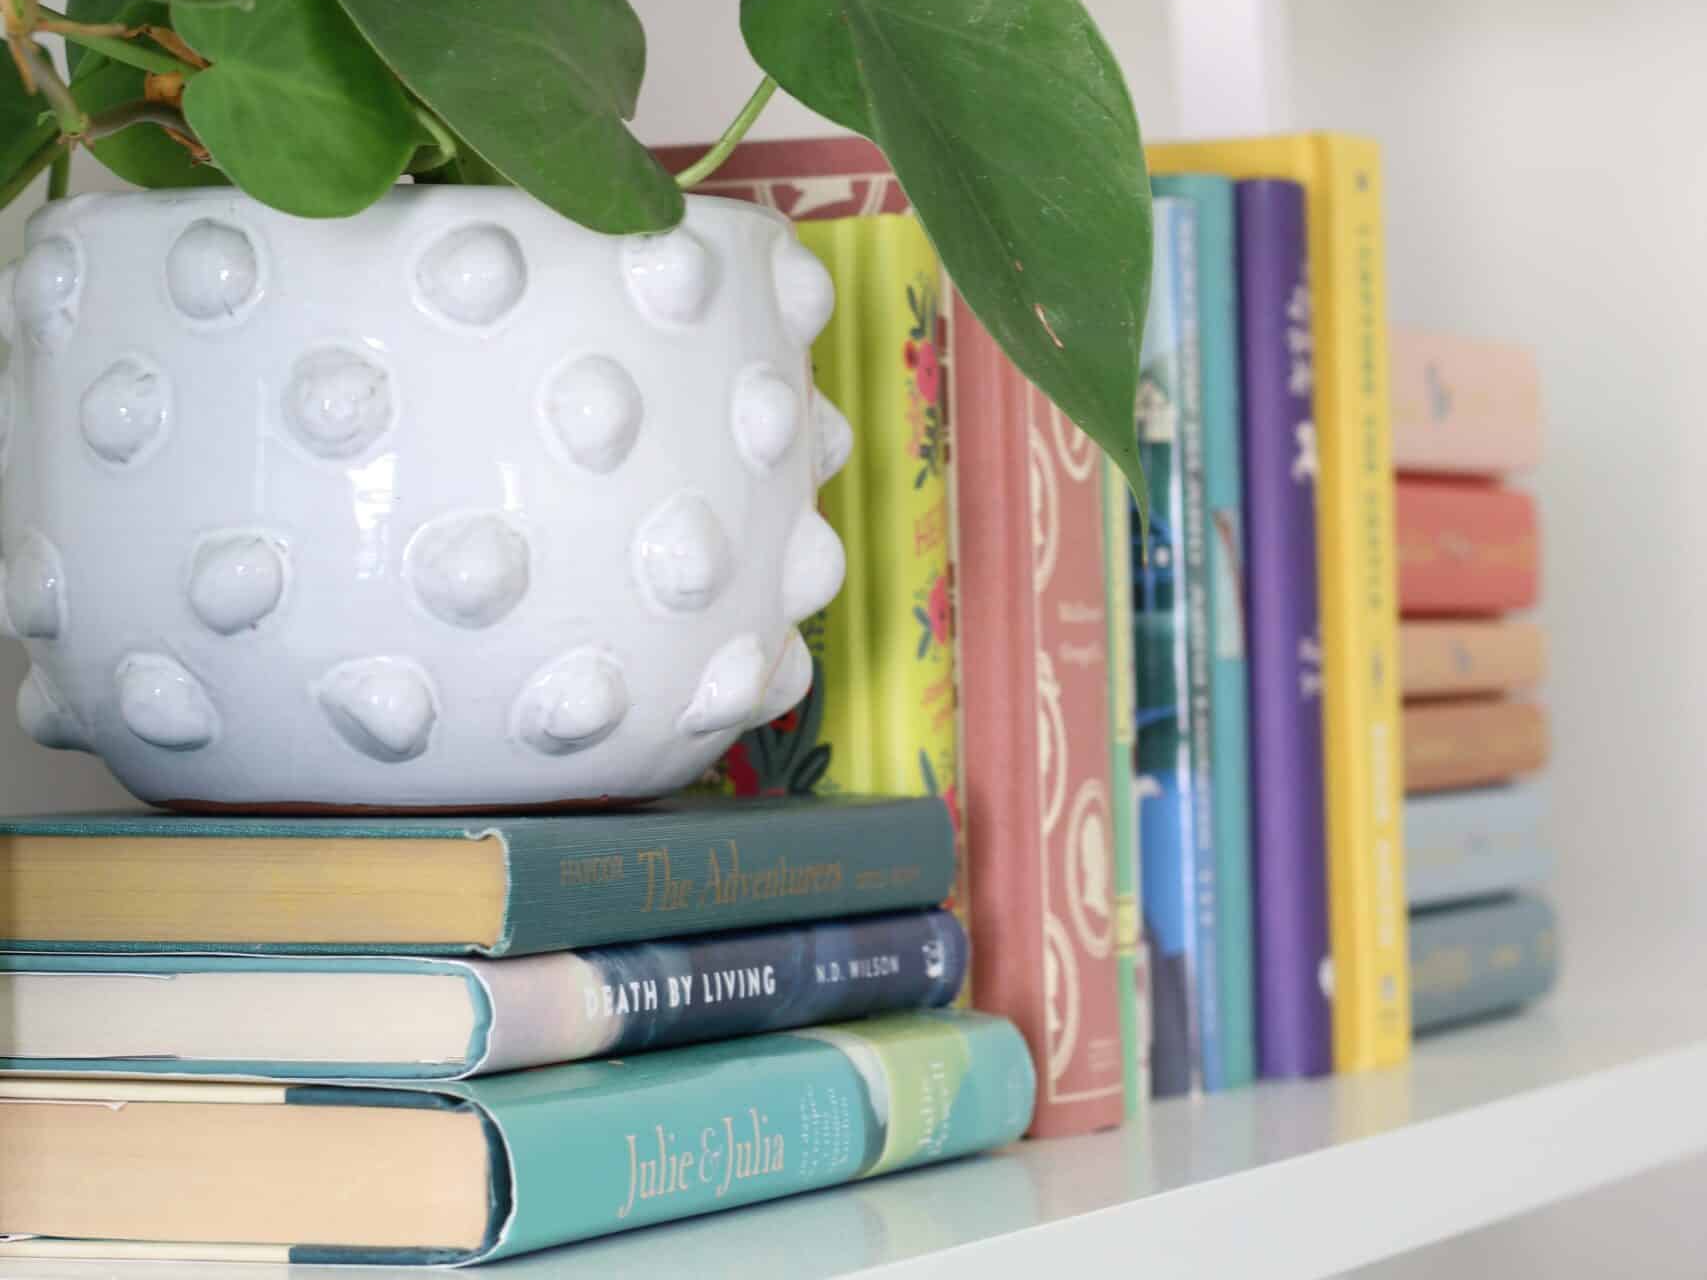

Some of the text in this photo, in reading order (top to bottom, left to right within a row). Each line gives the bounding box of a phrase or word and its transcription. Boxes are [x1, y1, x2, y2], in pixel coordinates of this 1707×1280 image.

[637, 846, 695, 914] The
[585, 965, 777, 1019] DEATH BY LIVING
[815, 955, 900, 984] N.D. WILSON
[616, 1122, 695, 1219] Julie
[714, 1106, 786, 1200] Julia
